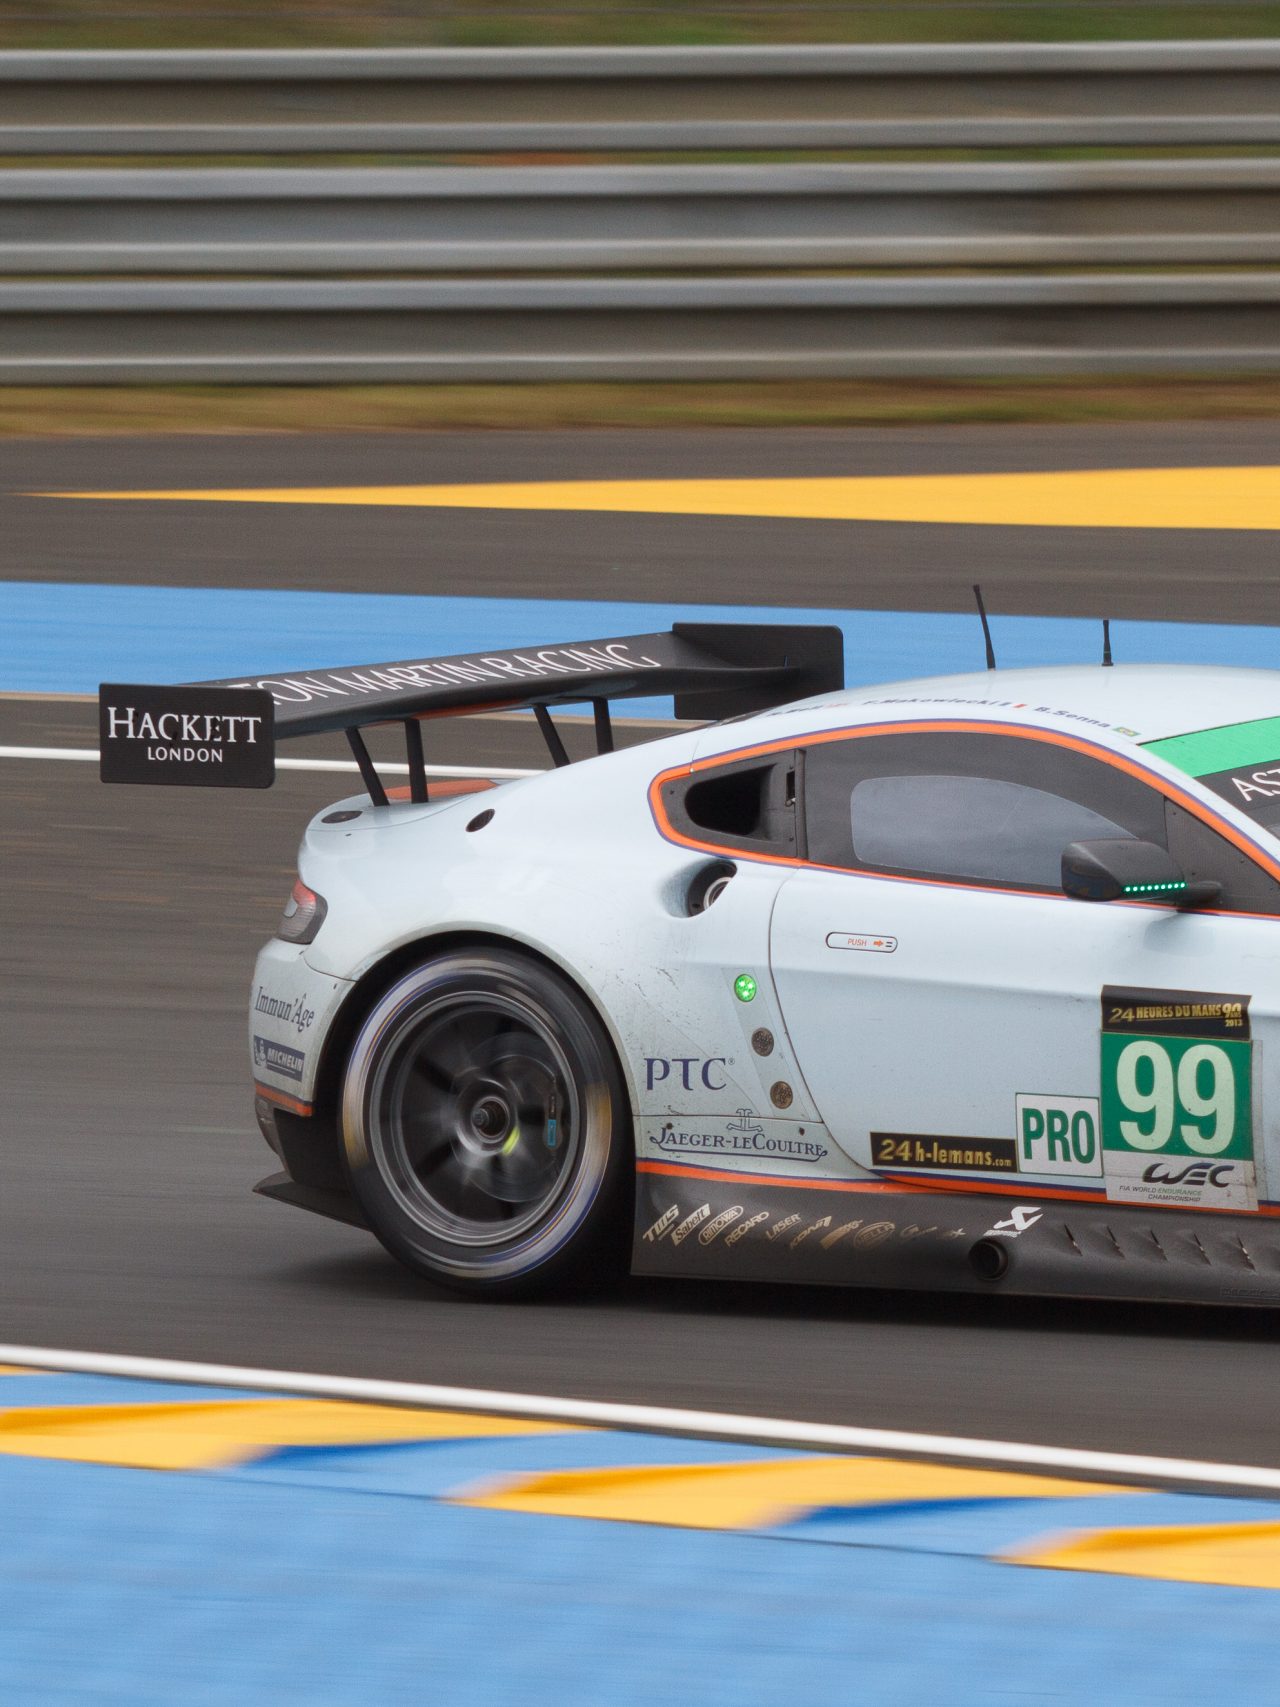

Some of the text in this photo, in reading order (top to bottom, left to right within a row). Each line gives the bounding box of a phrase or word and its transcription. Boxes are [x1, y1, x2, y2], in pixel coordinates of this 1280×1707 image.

[328, 660, 505, 695] MARTIN
[480, 644, 661, 677] RACING
[108, 707, 261, 743] HACKETT
[148, 746, 223, 763] LONDON
[847, 938, 867, 947] PUSH
[1108, 1007, 1135, 1024] 24
[1136, 1006, 1174, 1019] HEURES
[1175, 1005, 1190, 1017] DU
[1191, 1004, 1222, 1016] MANS
[1225, 1018, 1242, 1027] 2013
[267, 1047, 304, 1072] MICHELIN
[644, 1058, 727, 1091] PTC
[1117, 1041, 1235, 1154] 99
[1022, 1107, 1096, 1164] PRO
[1142, 1162, 1235, 1188] WEC
[1157, 1188, 1203, 1196] ENDURANCE
[724, 1211, 770, 1247] RECARO
[765, 1213, 801, 1240] LASER
